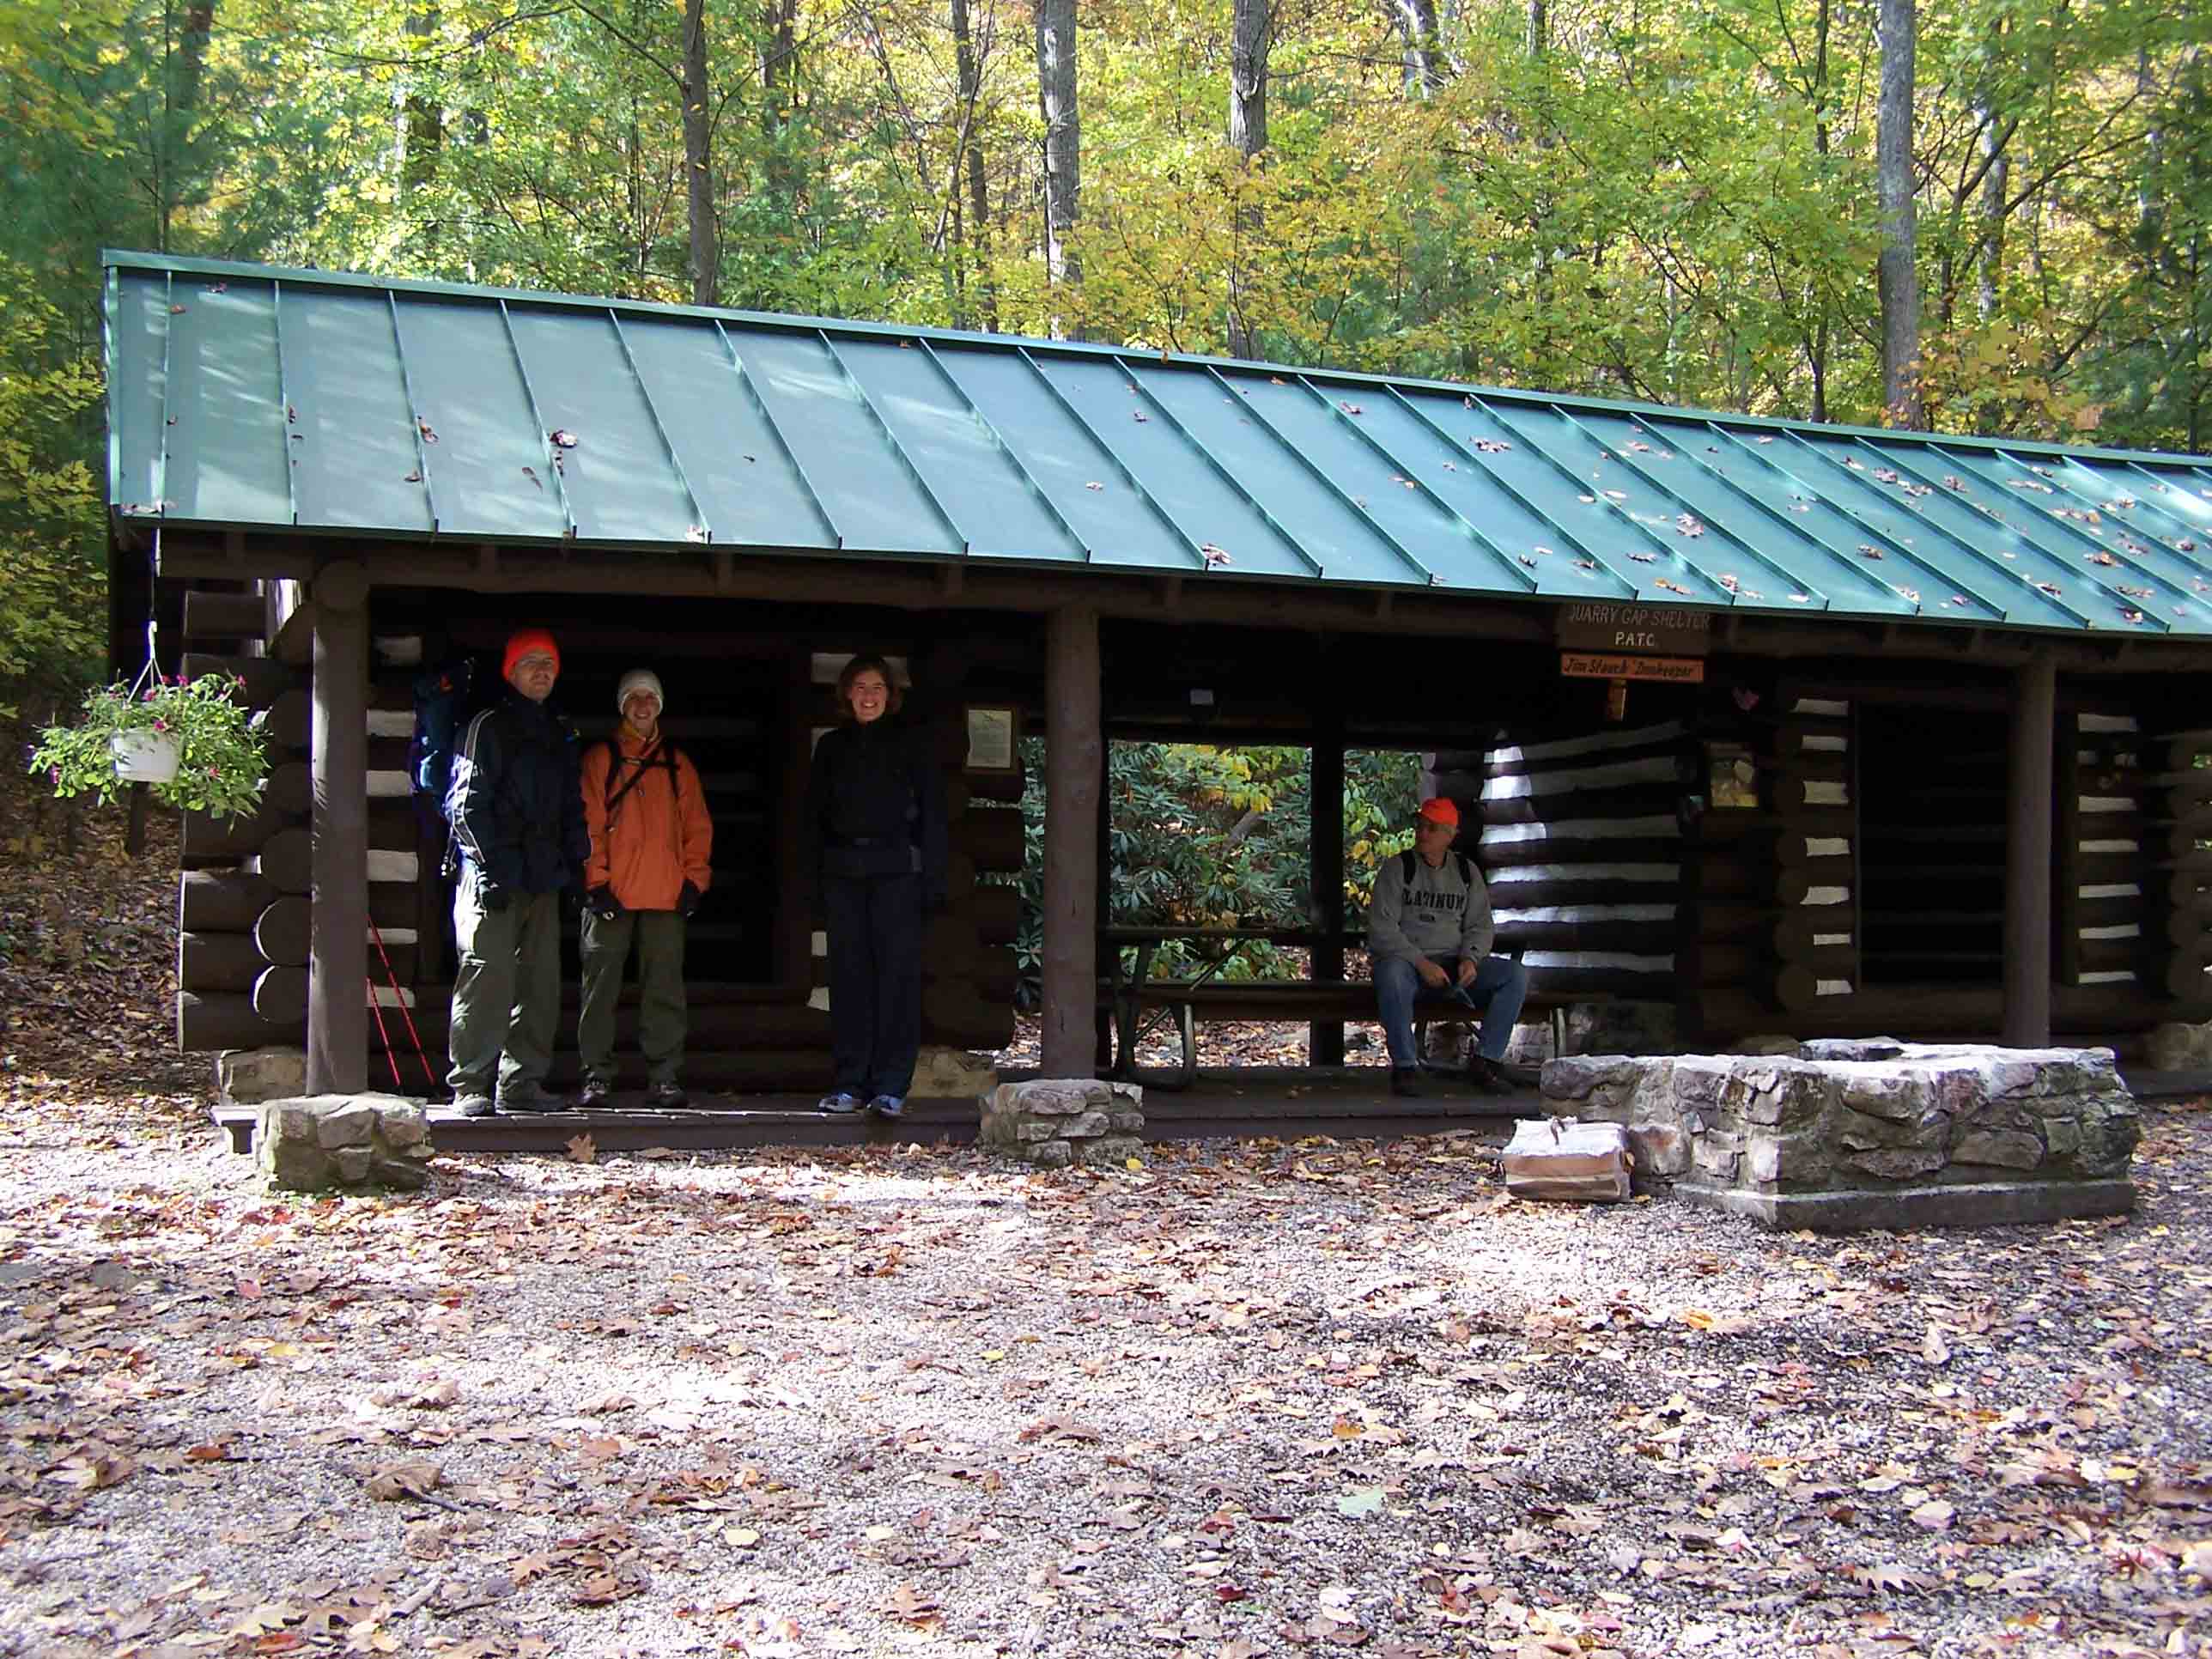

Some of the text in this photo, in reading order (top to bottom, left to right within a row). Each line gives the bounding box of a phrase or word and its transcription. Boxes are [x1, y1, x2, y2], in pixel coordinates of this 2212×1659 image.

[1620, 606, 1649, 626] GAP
[1650, 611, 1711, 631] SHELTER
[1564, 658, 1587, 674] Jim
